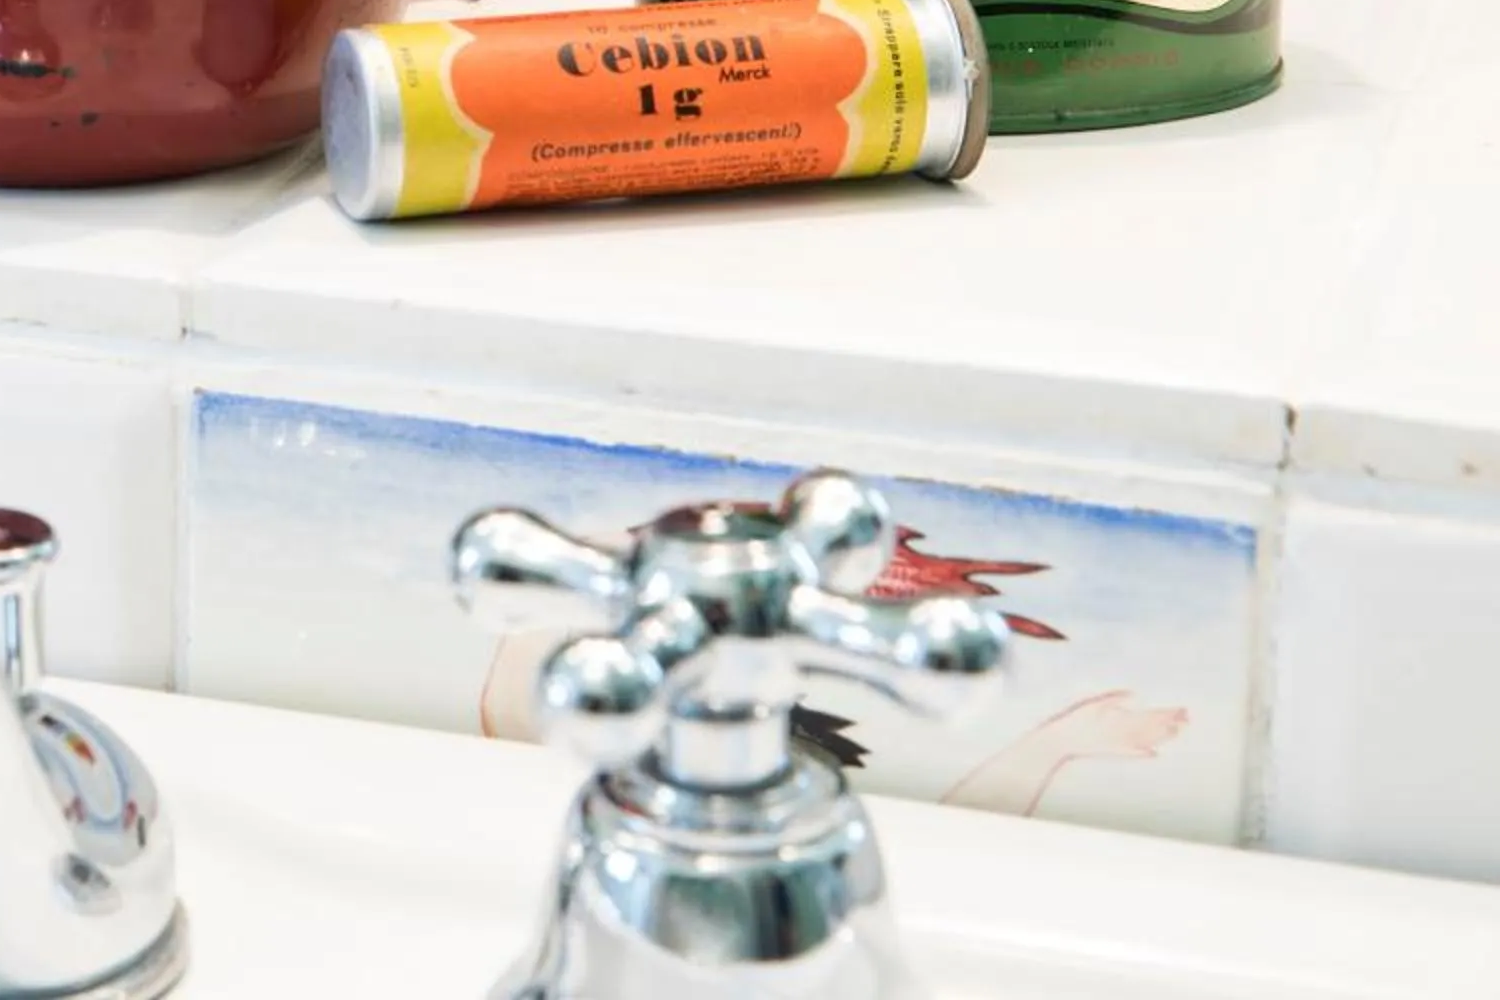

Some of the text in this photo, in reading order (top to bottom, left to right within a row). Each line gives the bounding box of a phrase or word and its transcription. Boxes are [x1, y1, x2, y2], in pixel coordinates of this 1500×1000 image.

[557, 34, 766, 78] Cebion
[718, 64, 772, 83] Merck
[673, 87, 704, 121] g
[531, 138, 654, 163] (Compresse
